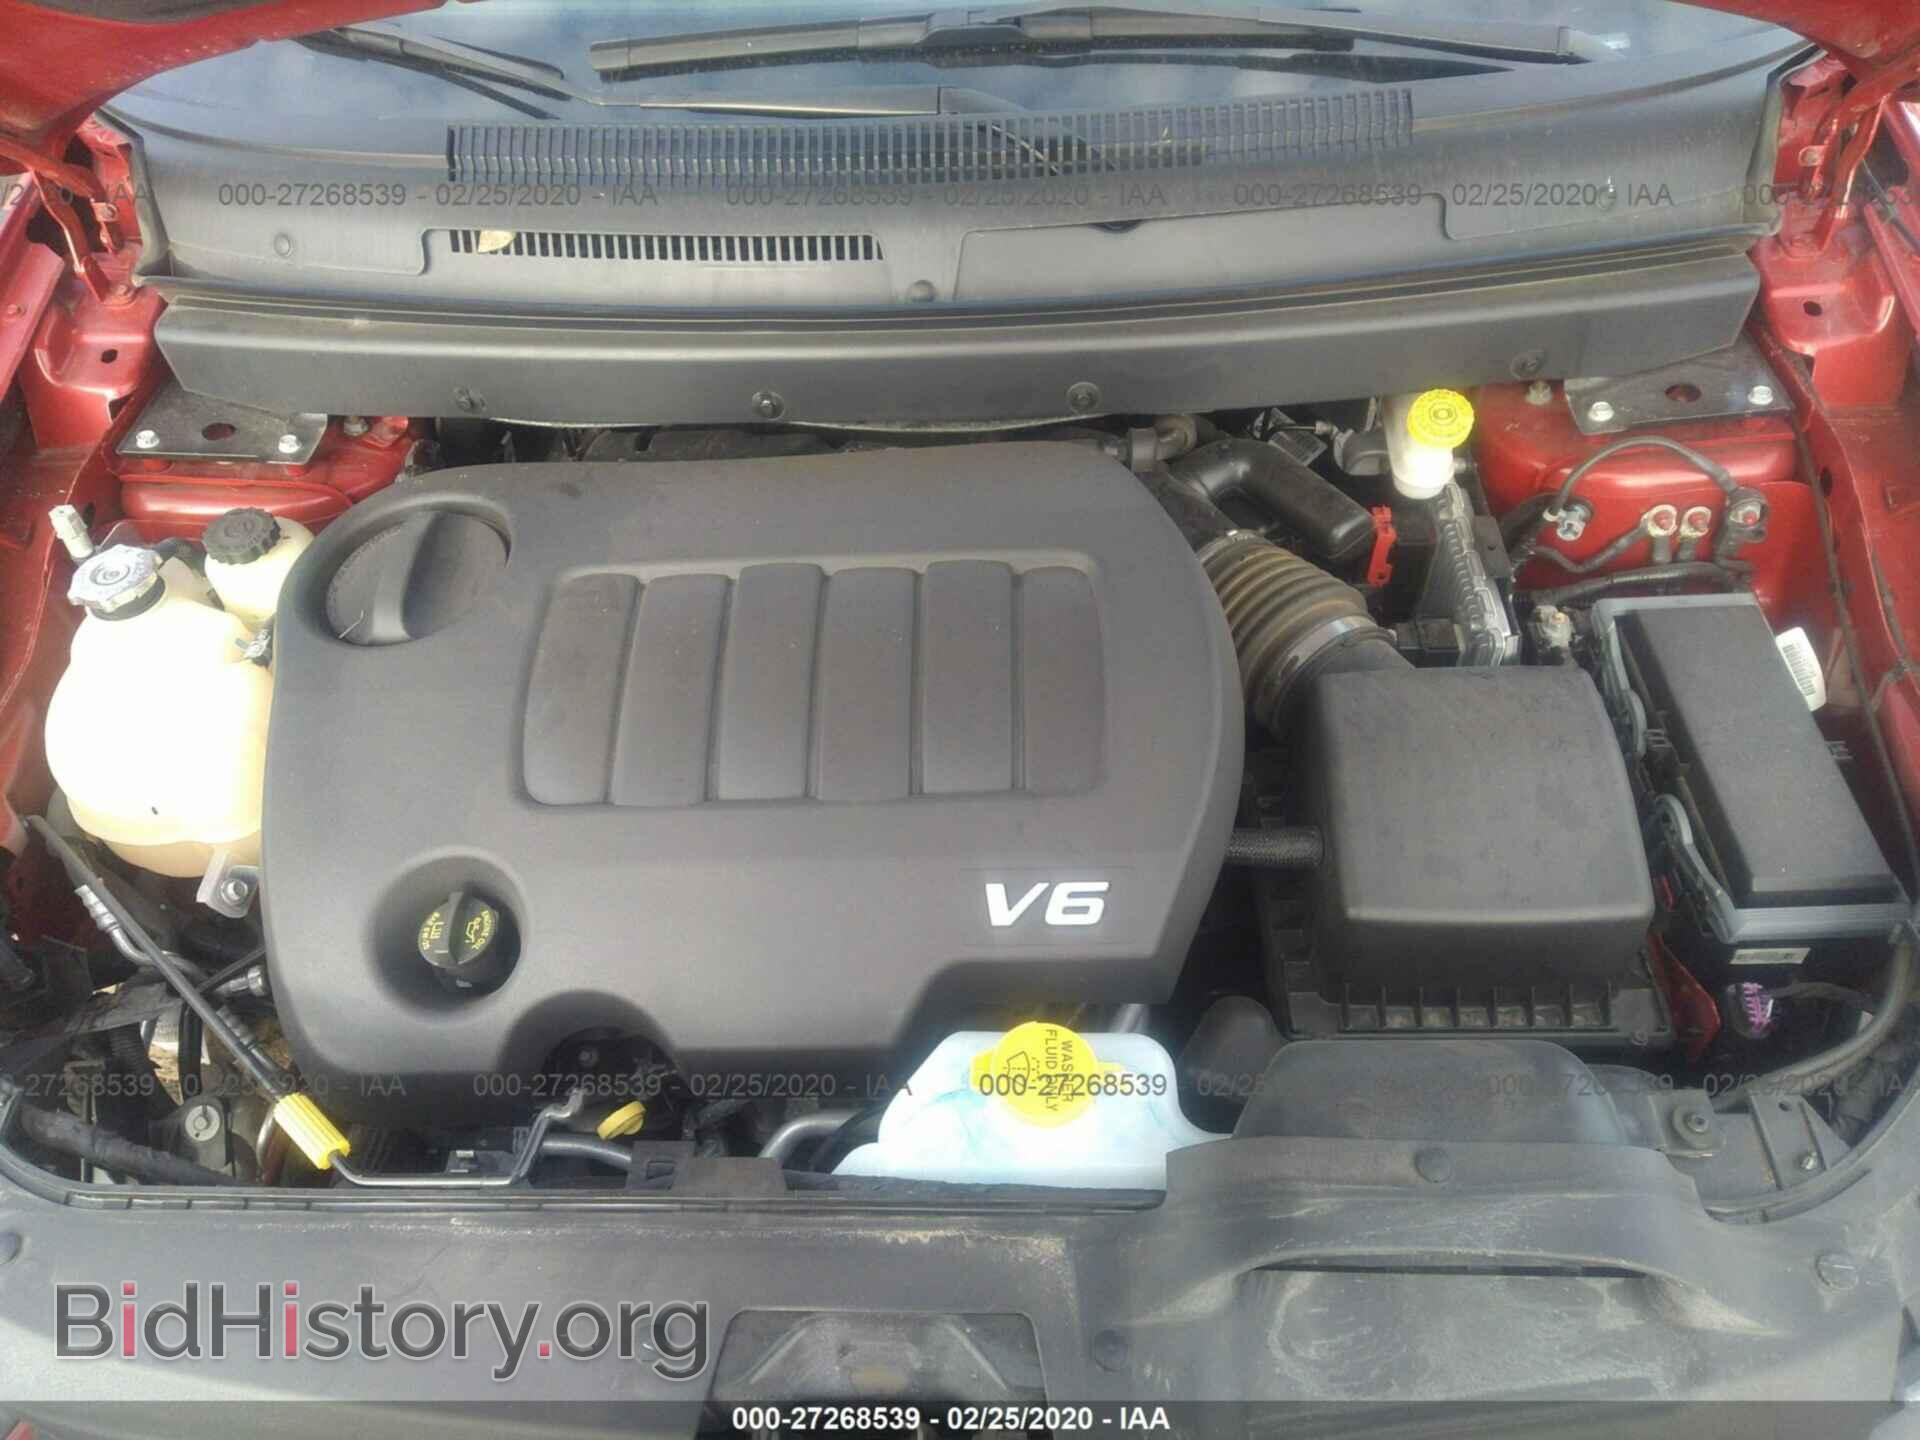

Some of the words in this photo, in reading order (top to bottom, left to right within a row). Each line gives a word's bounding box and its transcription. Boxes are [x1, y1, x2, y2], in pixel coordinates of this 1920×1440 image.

[985, 881, 1110, 926] V6
[1044, 1028, 1058, 1070] FLUID
[1044, 1074, 1059, 1112] ONLY
